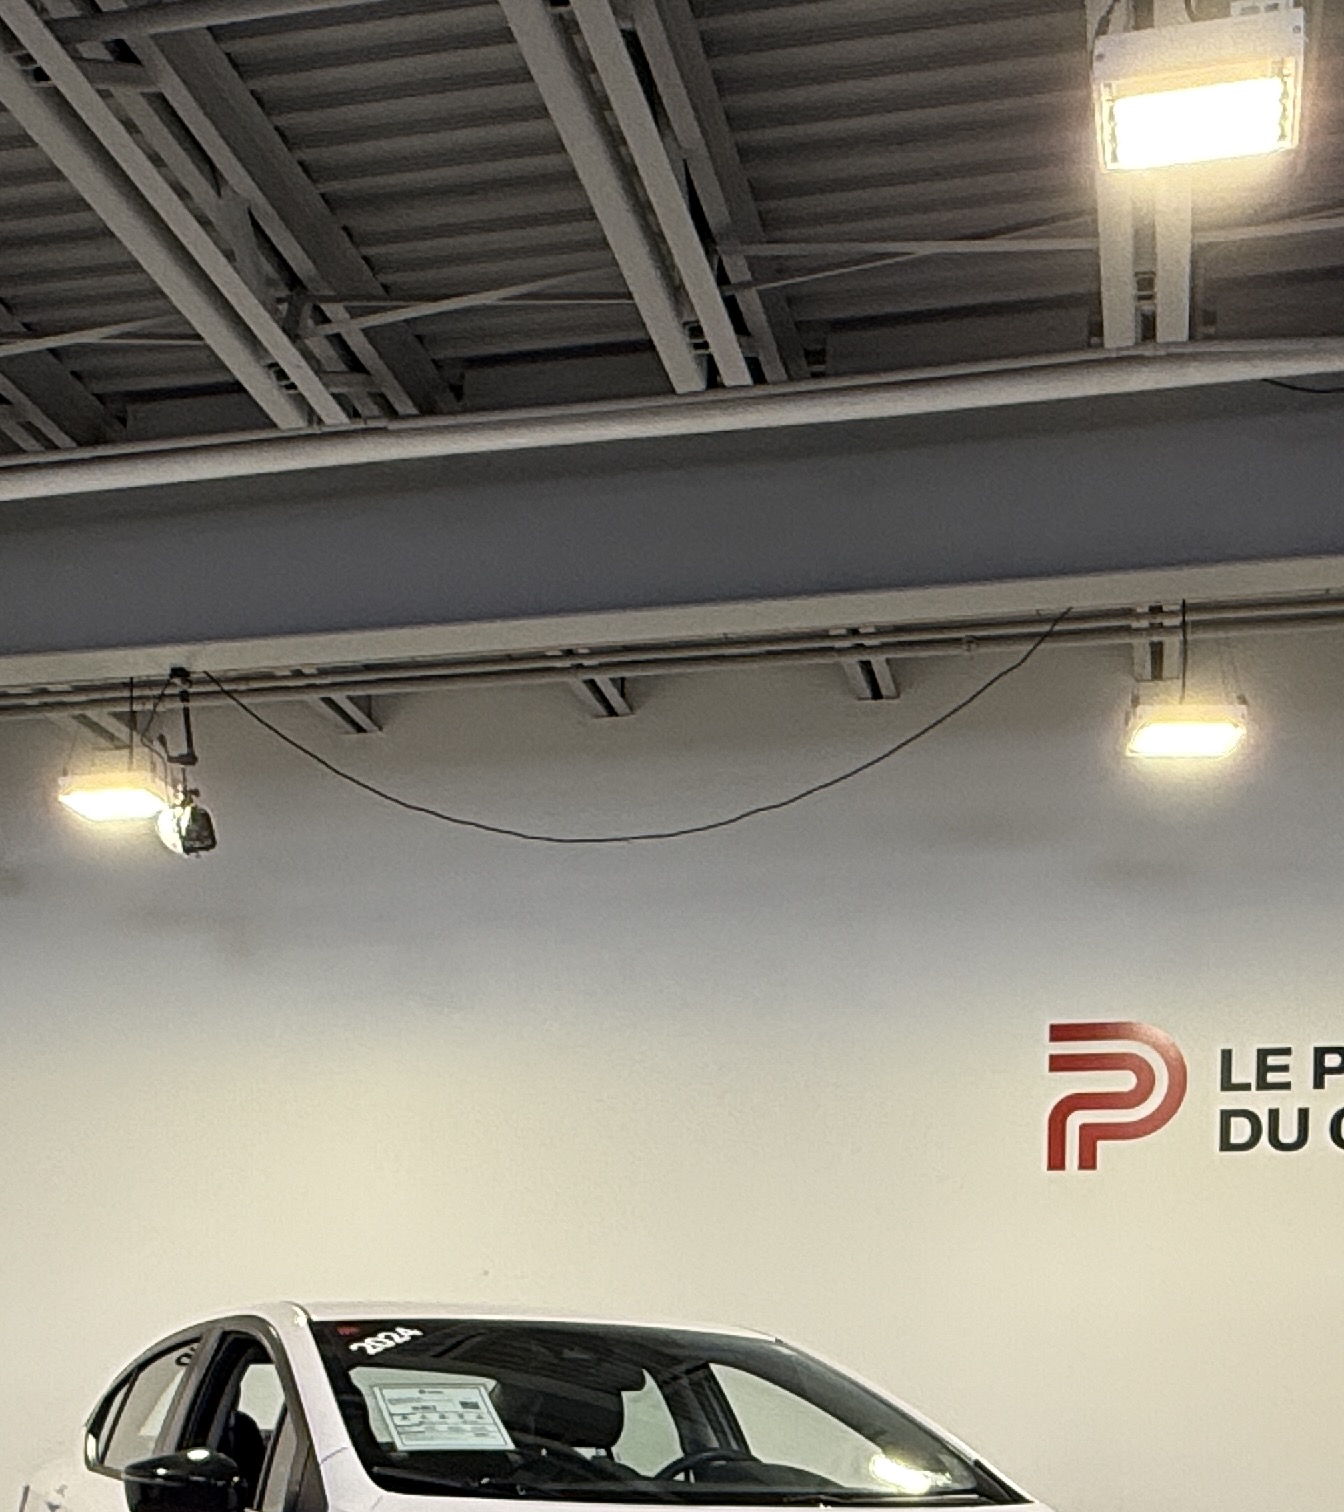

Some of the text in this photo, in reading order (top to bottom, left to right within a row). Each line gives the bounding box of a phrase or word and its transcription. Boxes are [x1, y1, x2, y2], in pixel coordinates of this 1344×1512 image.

[1219, 1046, 1292, 1092] LE
[1218, 1107, 1310, 1152] DU
[348, 1326, 424, 1355] 2024
